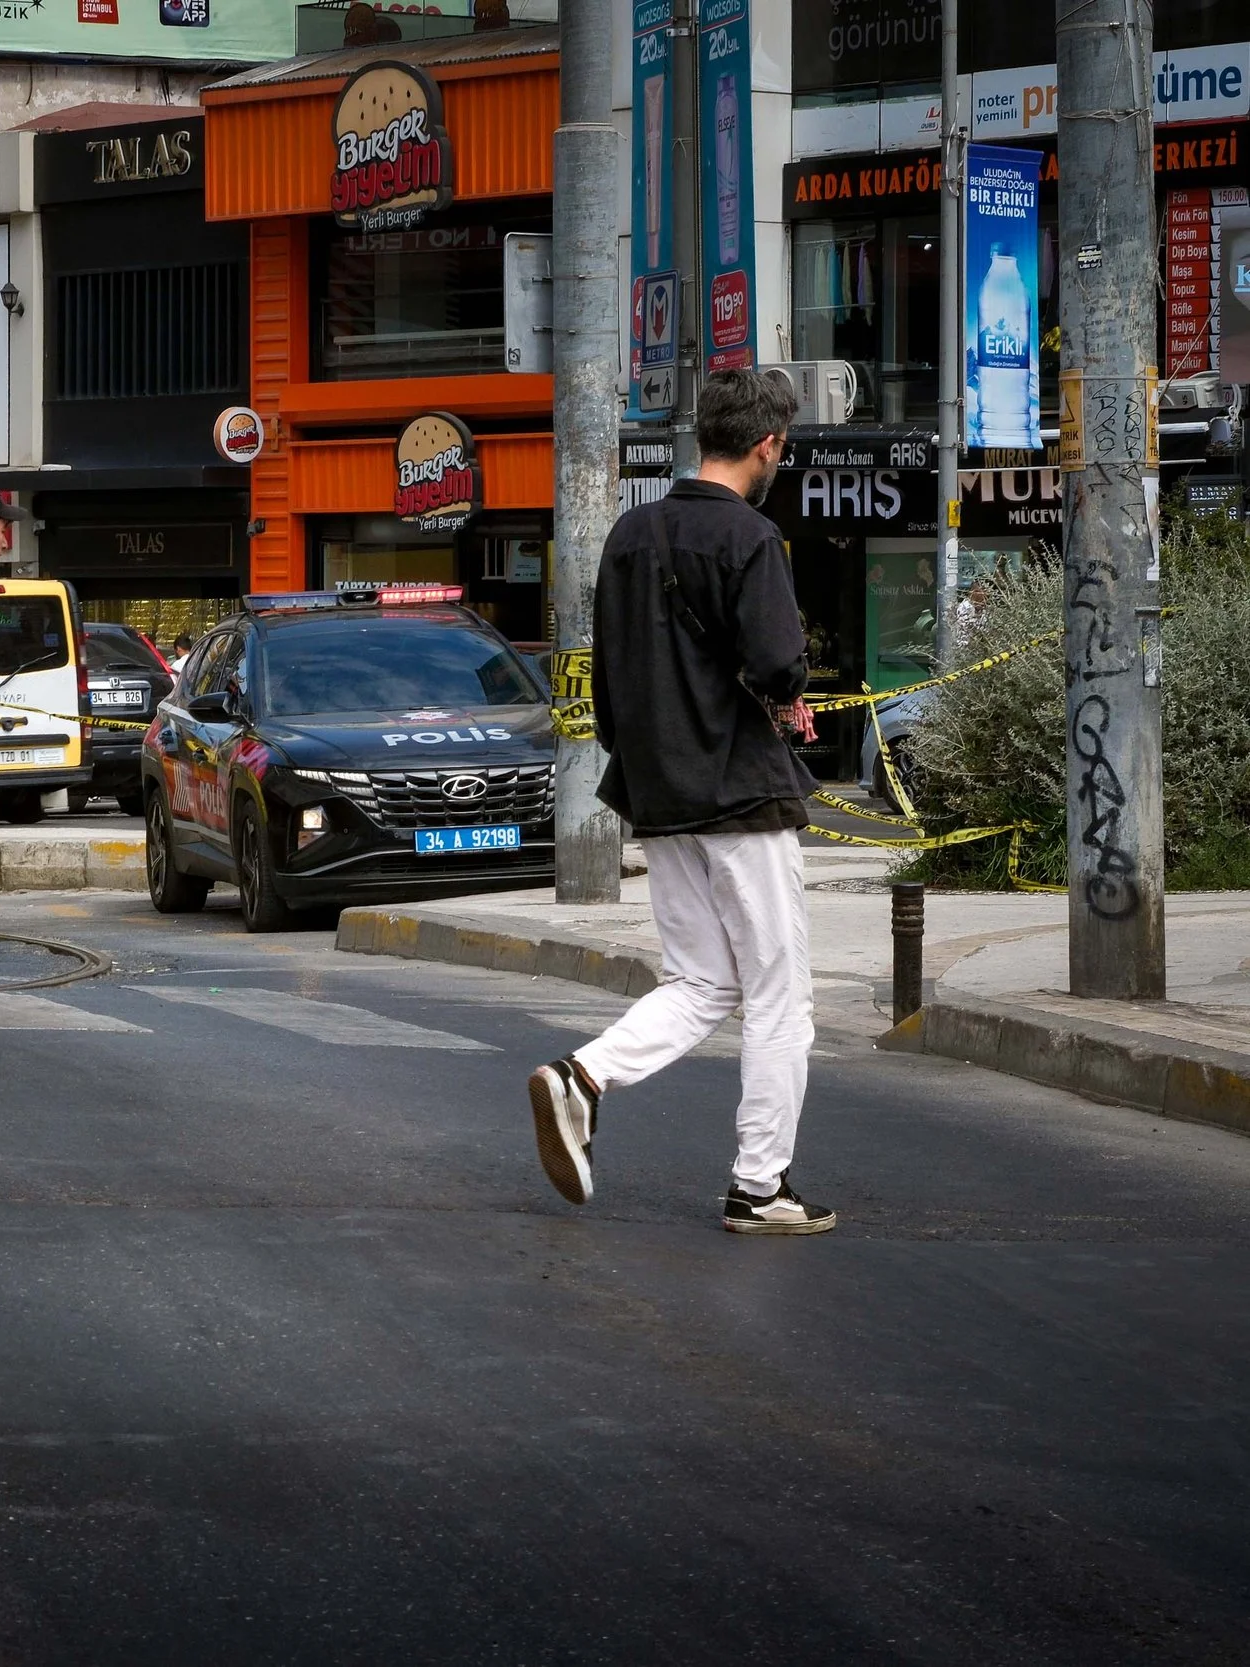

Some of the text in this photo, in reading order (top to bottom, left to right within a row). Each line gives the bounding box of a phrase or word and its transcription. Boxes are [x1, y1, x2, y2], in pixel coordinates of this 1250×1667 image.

[182, 10, 207, 22] APP
[977, 92, 1015, 109] noter
[976, 108, 1018, 125] yeminli
[85, 130, 191, 184] TALAS
[1153, 128, 1238, 172] ERKEZİ
[983, 167, 1022, 180] ULUDAĞ'IN
[795, 174, 852, 203] ARDA
[969, 176, 1035, 191] BENZERSİZ DOĞASI
[970, 186, 1035, 208] BİR ERİKLİ
[1172, 192, 1188, 204] Fön
[978, 203, 1027, 219] UZAĞINDA
[1192, 208, 1208, 221] Fön
[1172, 227, 1197, 241] Kesim
[1172, 245, 1208, 259] Dip Boya
[1171, 265, 1193, 279] Maşa
[1171, 283, 1196, 298] Topuz
[1171, 303, 1193, 316] Röfle
[1171, 320, 1196, 335] Balyaj
[985, 334, 1024, 356] Erikli
[645, 346, 670, 360] METRO
[810, 448, 845, 467] Pırlanta
[846, 448, 874, 466] Sanatı
[984, 448, 1034, 468] MURAT
[115, 531, 165, 554] TALAS
[91, 690, 141, 704] 34 TE 826
[381, 726, 512, 748] POLİS
[425, 827, 516, 850] 34 A 92198
